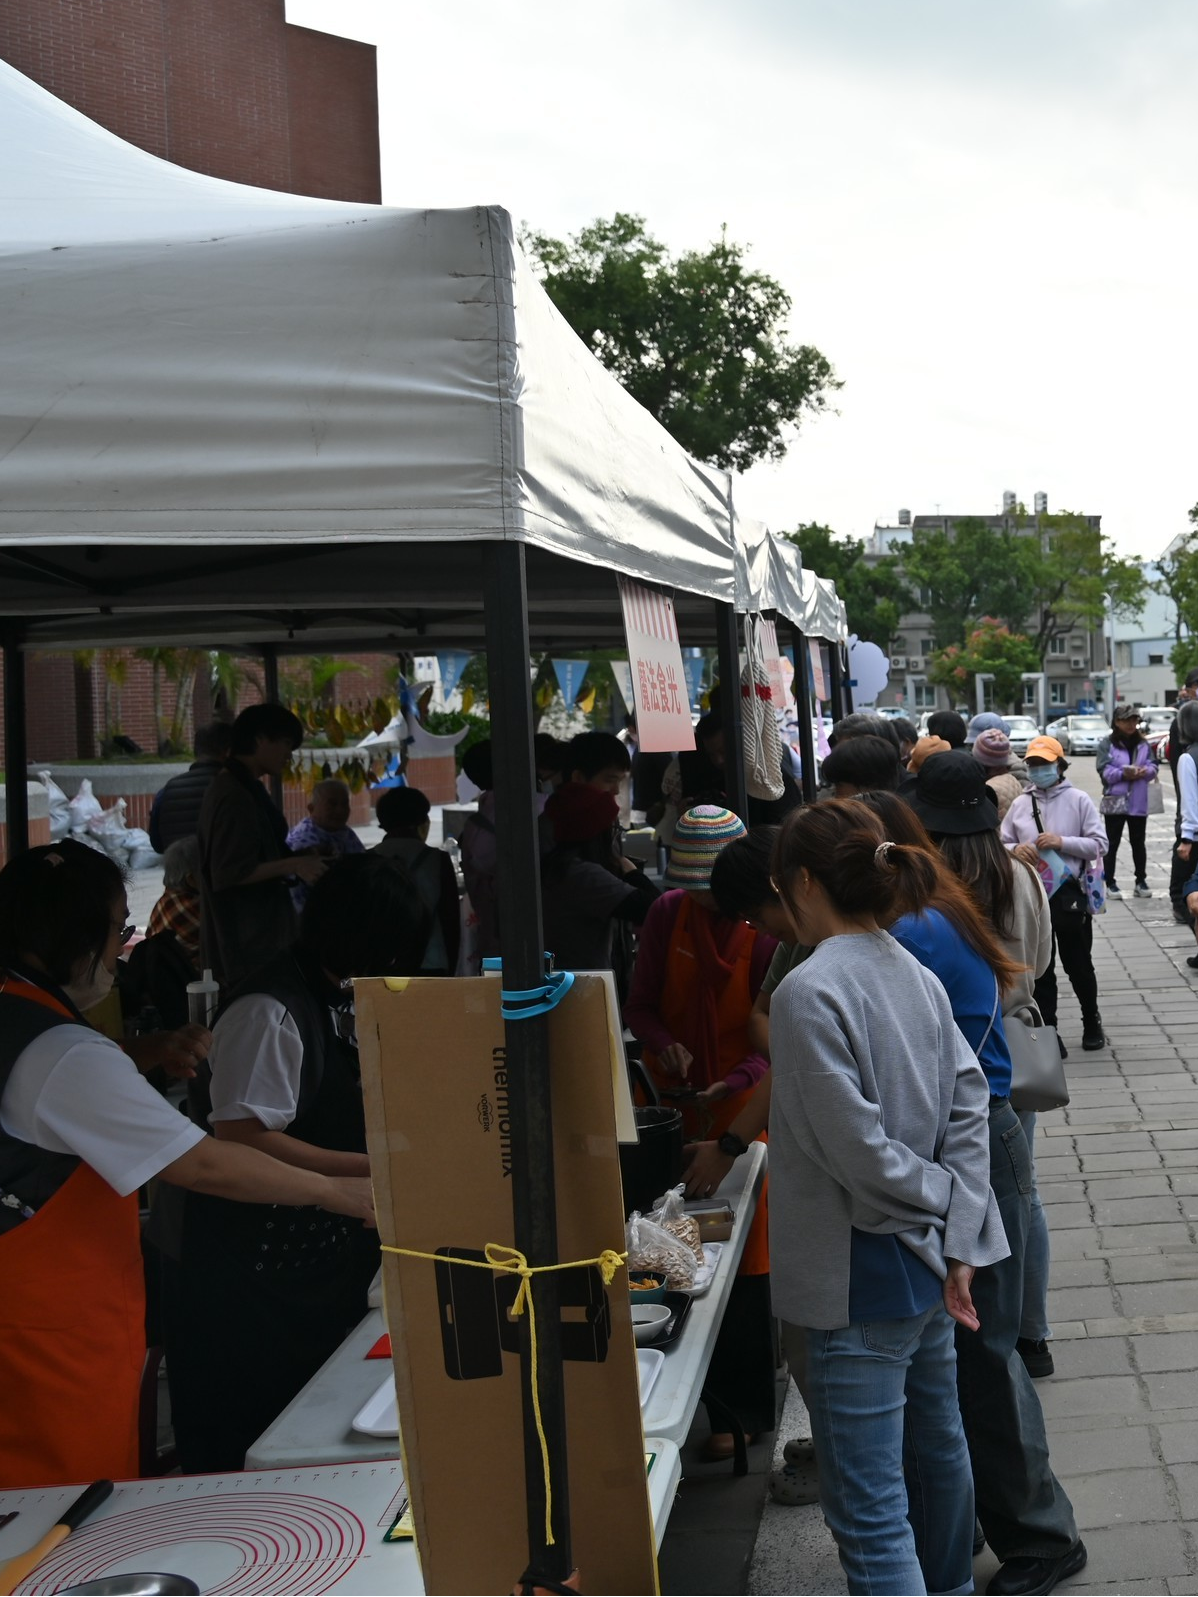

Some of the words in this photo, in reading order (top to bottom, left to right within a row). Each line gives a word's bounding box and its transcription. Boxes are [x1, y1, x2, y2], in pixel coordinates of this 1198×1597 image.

[637, 657, 682, 715] 魔法食光
[480, 1093, 490, 1132] VORWERK
